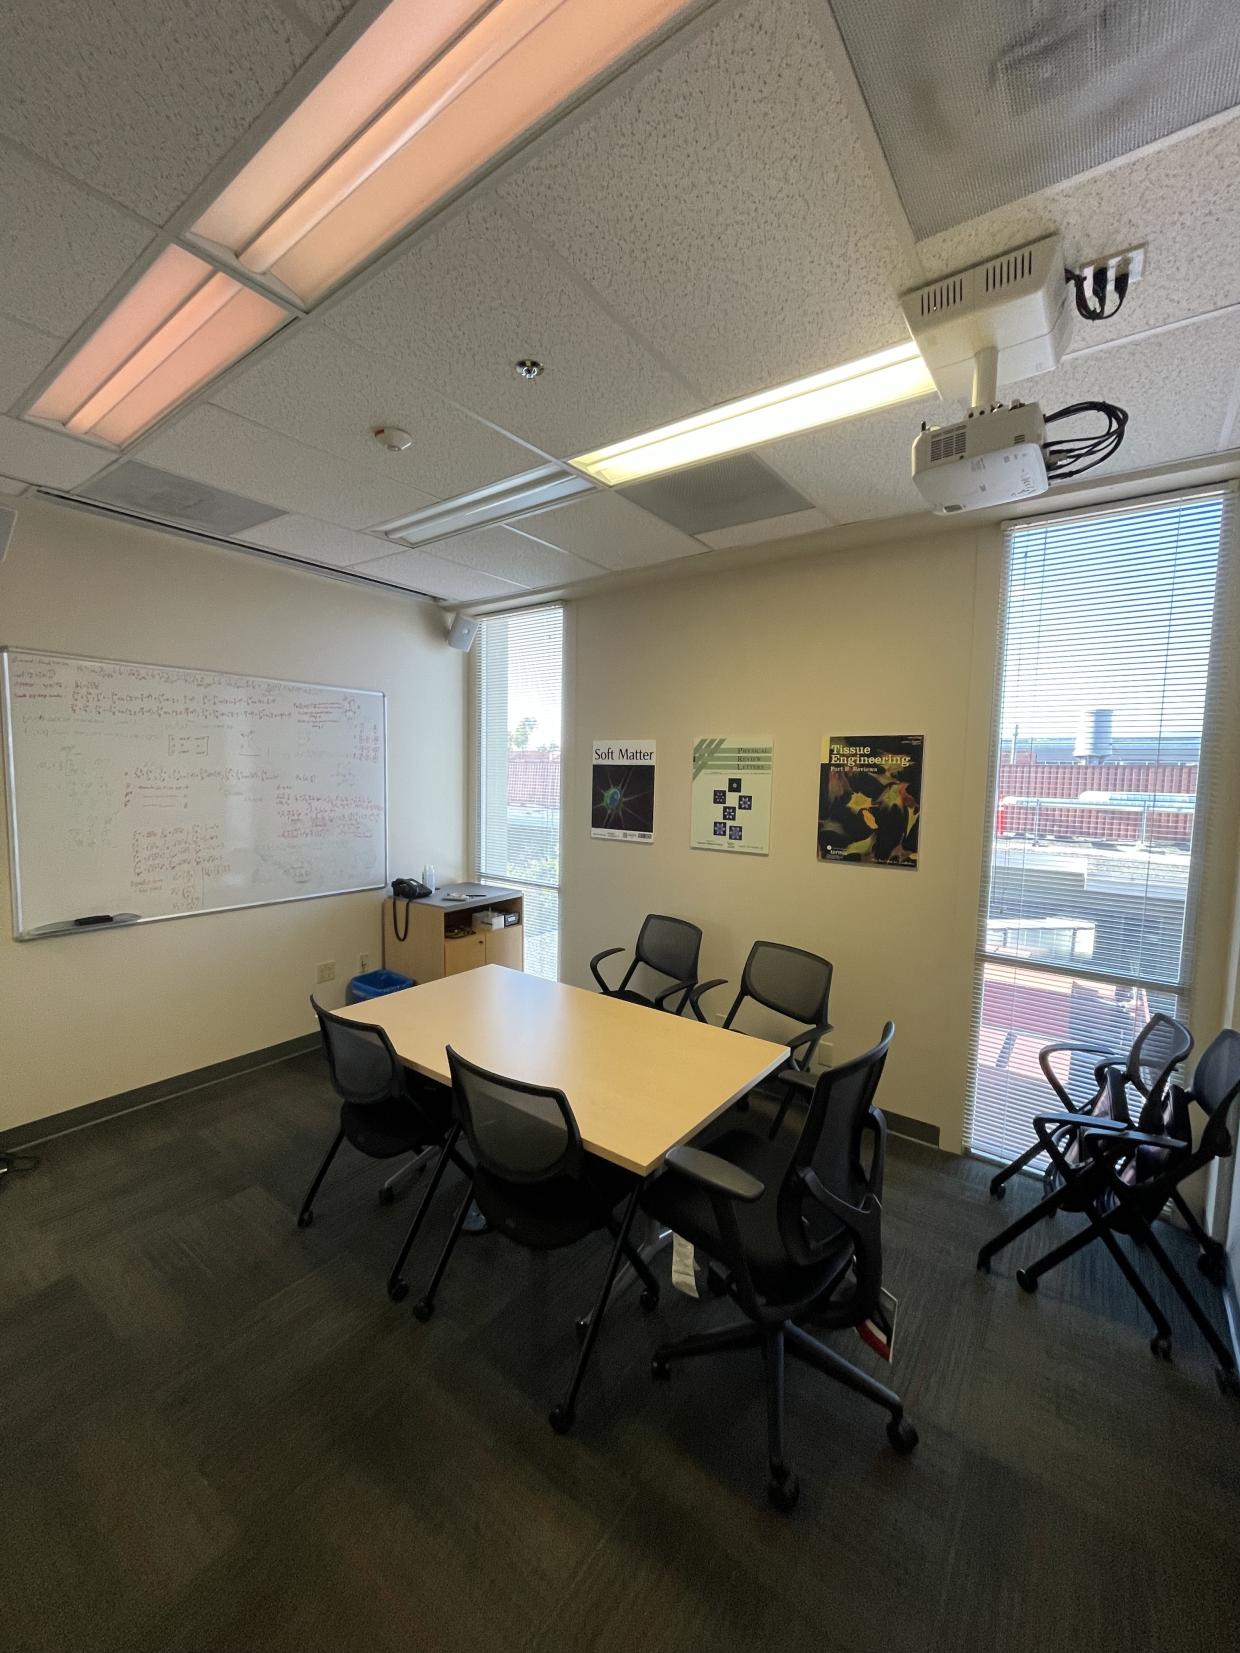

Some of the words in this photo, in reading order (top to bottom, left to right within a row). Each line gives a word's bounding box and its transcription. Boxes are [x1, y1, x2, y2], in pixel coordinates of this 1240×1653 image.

[594, 747, 615, 761] Soft
[618, 747, 655, 761] Matter
[831, 744, 871, 755] Tissue
[830, 754, 911, 767] Engineering
